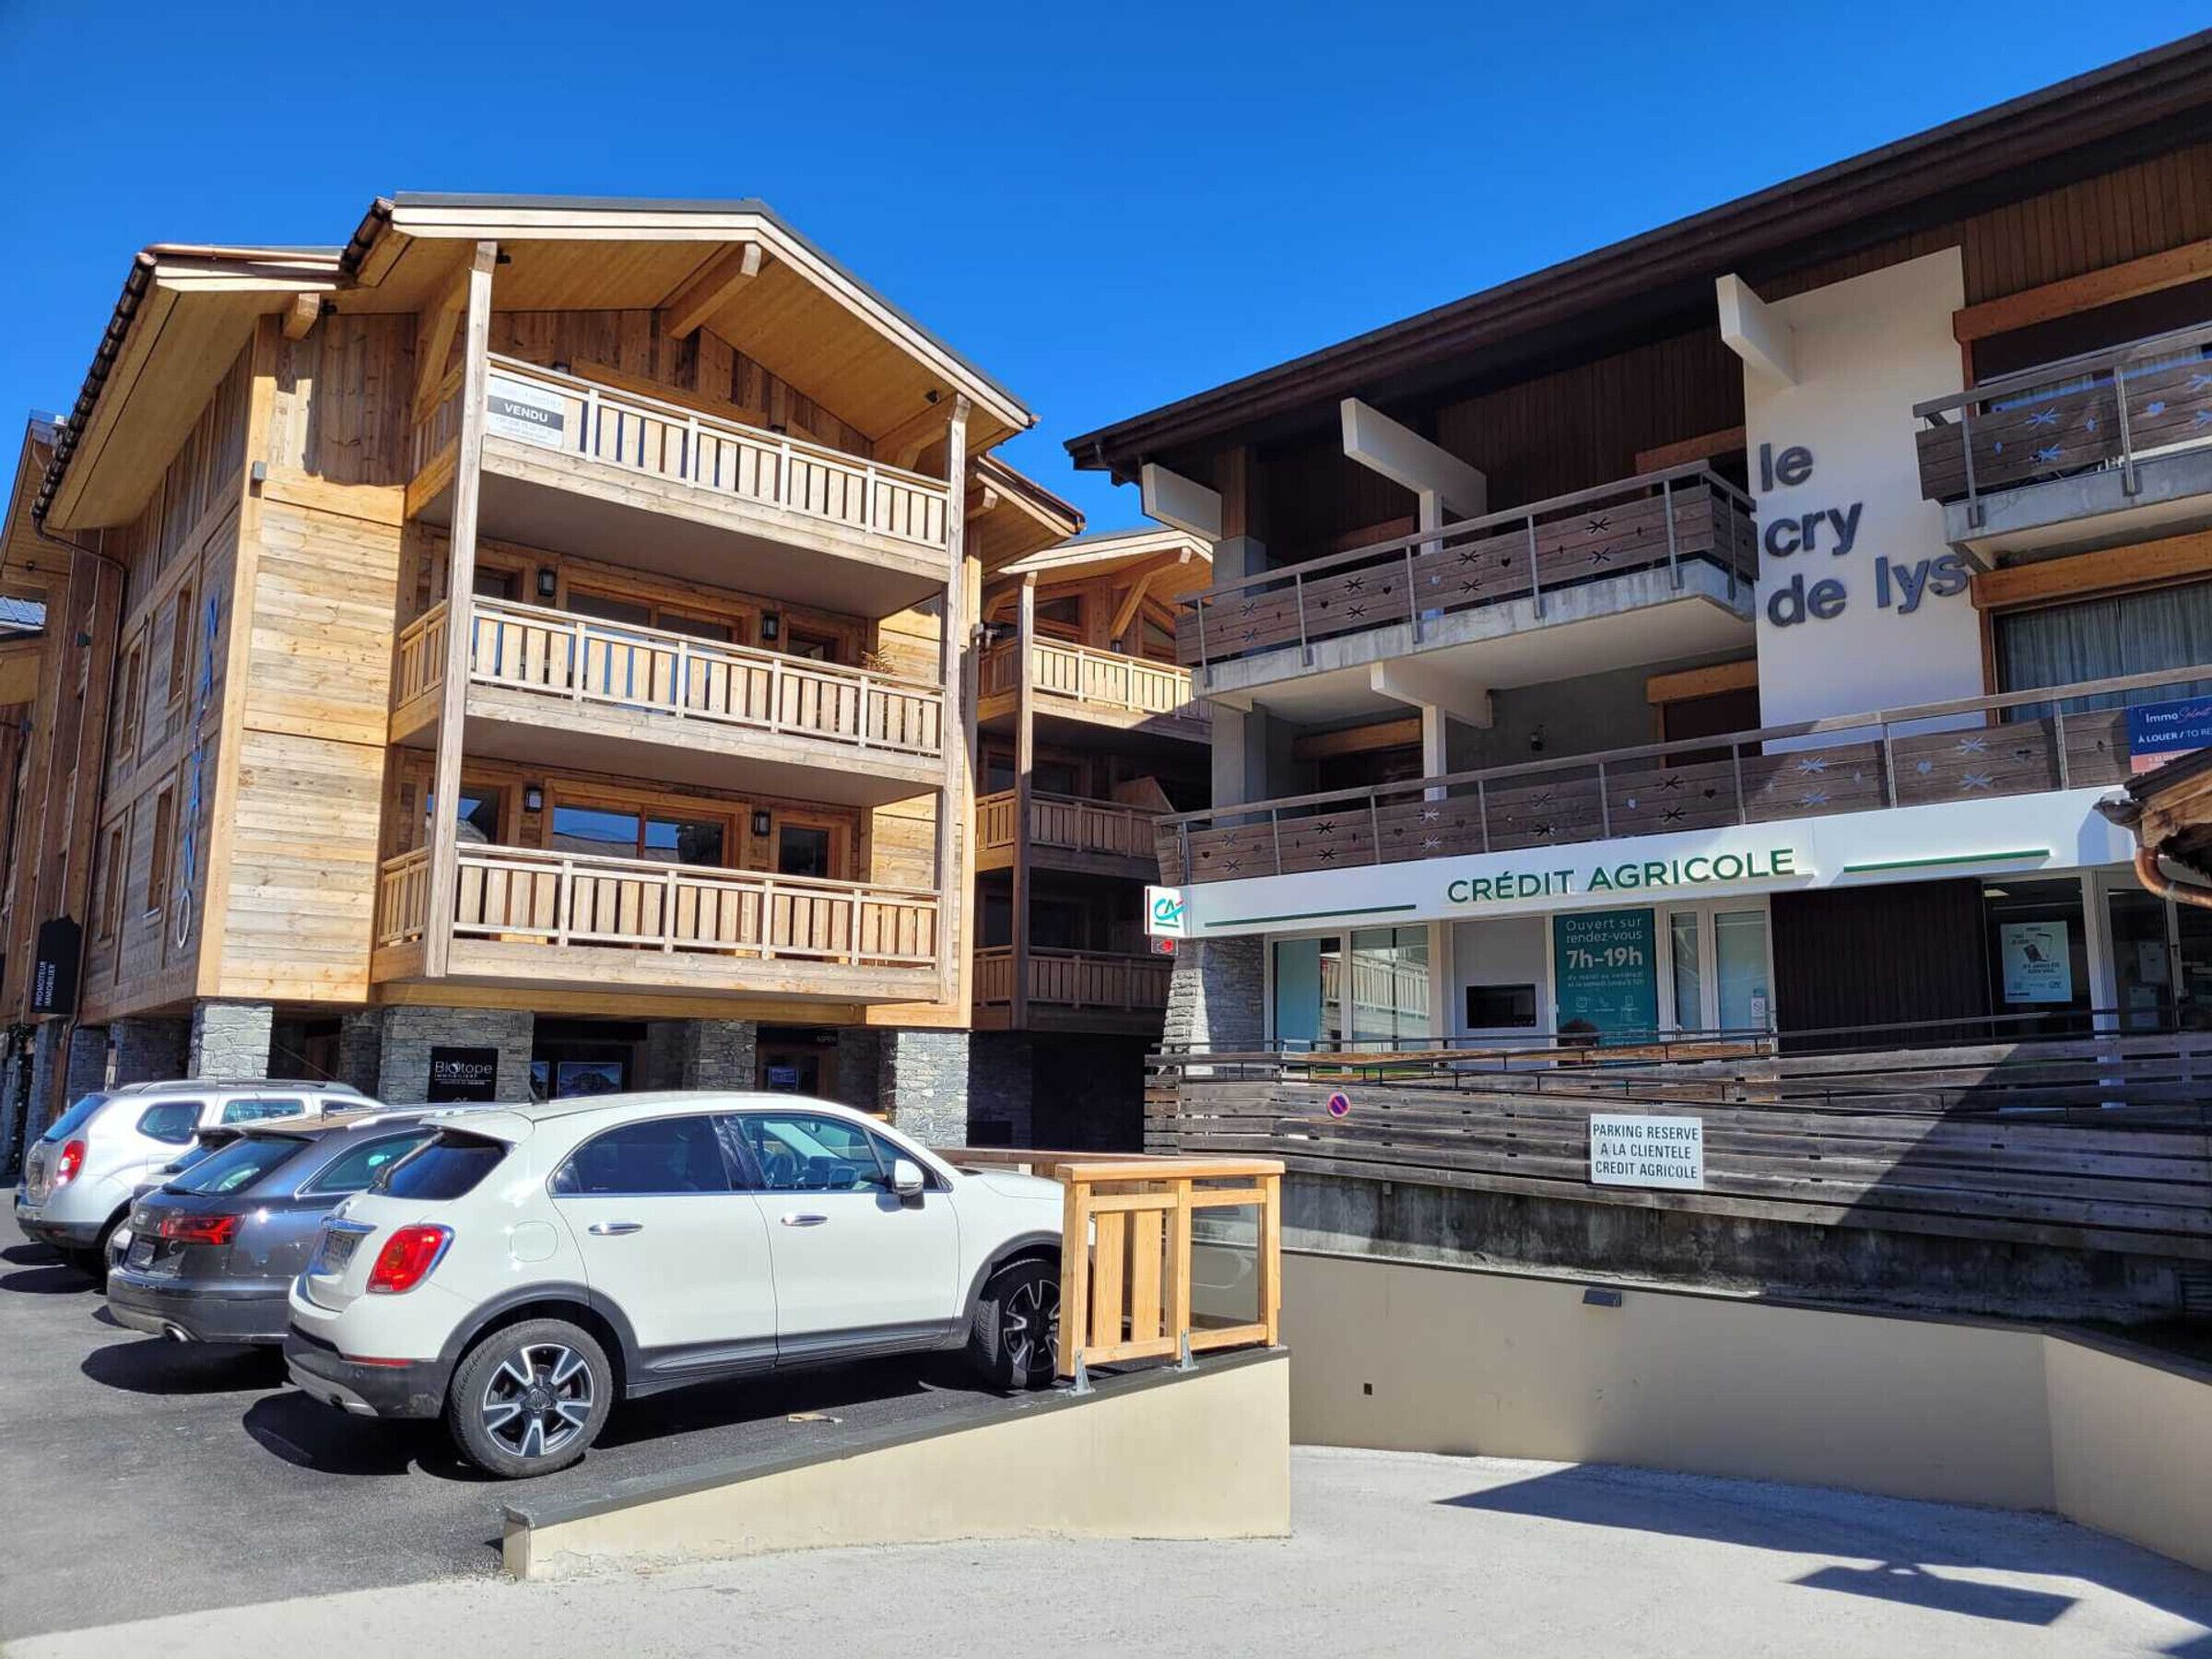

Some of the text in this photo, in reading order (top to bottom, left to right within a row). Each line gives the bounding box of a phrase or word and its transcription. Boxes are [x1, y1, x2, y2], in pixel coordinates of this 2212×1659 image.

[504, 403, 548, 423] VENDU
[1759, 442, 1814, 492] le
[1764, 502, 1863, 558] cry
[1768, 555, 1969, 628] de lys
[2146, 732, 2178, 743] LOUER
[2185, 729, 2199, 738] TO
[1447, 848, 1796, 903] CRÉDIT AGRICOLE
[1566, 917, 1641, 932] Ouvert sur
[1566, 930, 1642, 944] rendez-vous
[435, 1061, 493, 1077] Biotope
[1593, 1124, 1699, 1141] PARKING RESERVE
[1600, 1143, 1691, 1159] A LA CLIENTELE
[1595, 1160, 1698, 1179] CREDIT AGRICOLE
